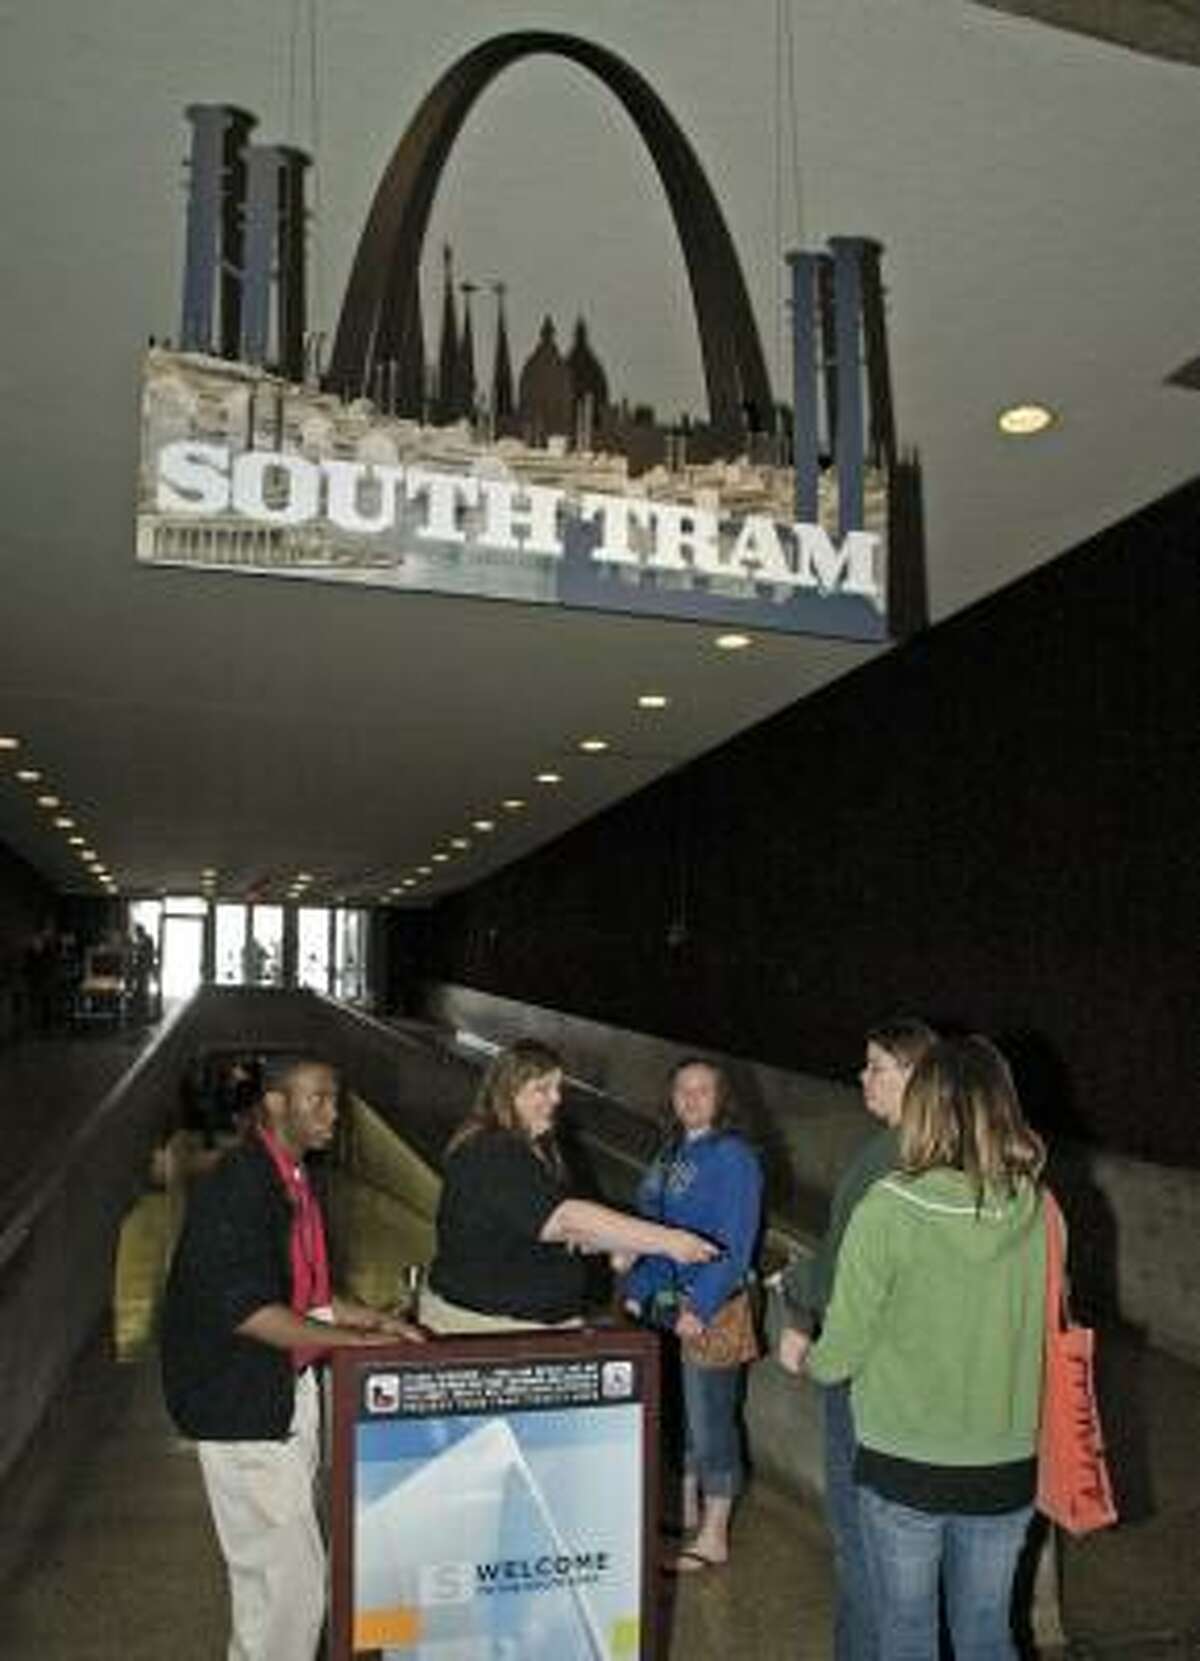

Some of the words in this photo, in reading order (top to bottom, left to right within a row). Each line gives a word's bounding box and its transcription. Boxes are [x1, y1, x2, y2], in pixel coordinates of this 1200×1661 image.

[155, 441, 566, 556] SOUTH
[582, 492, 880, 594] TRAM
[476, 1552, 609, 1582] WELCOME
